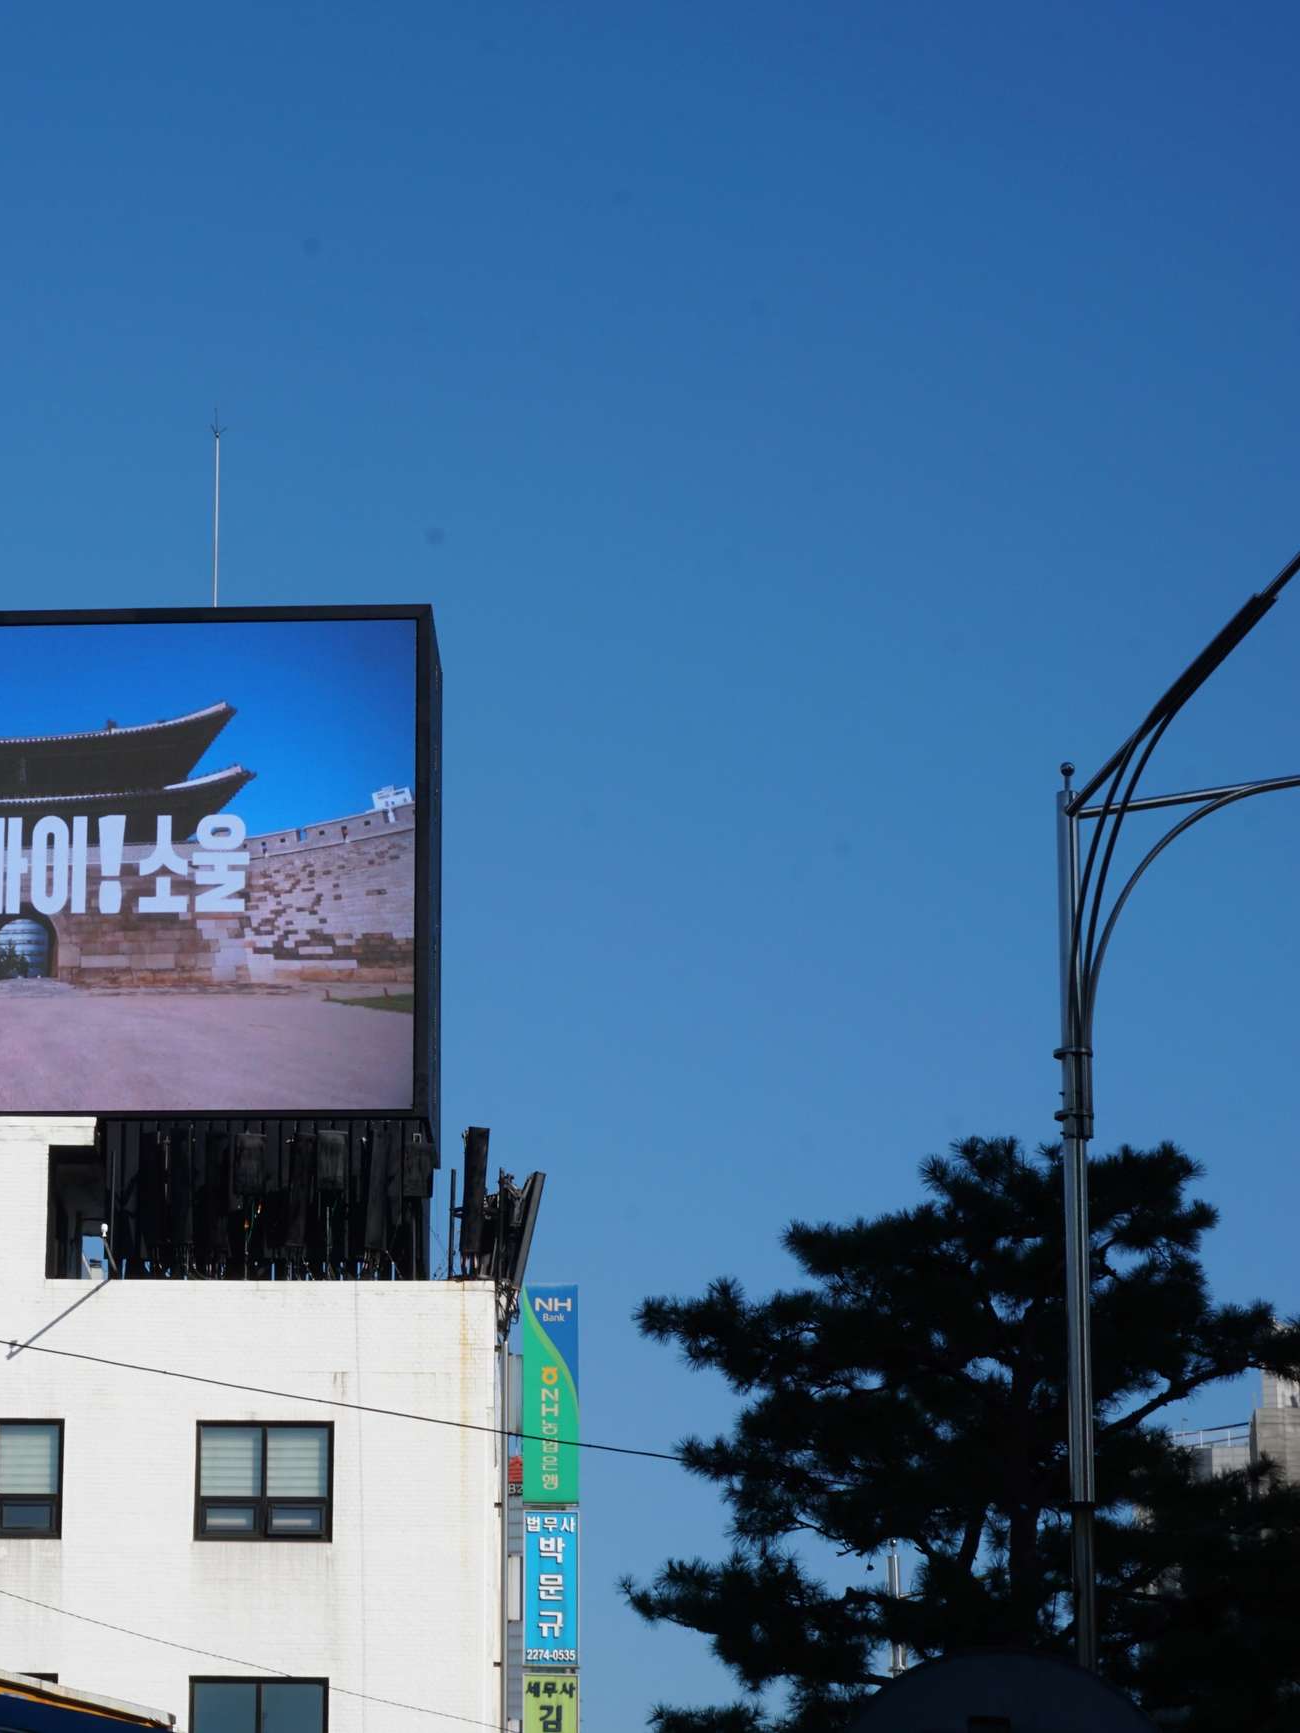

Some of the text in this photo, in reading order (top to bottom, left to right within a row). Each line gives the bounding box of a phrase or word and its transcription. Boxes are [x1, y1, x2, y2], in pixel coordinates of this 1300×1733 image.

[138, 813, 250, 913] 소울
[534, 1297, 572, 1312] NH
[542, 1313, 565, 1322] Bank
[526, 1515, 576, 1533] 법무사
[538, 1536, 566, 1638] 박문규
[526, 1648, 576, 1661] 2274-0535
[526, 1681, 576, 1698] 세무사
[538, 1704, 563, 1733] 김
